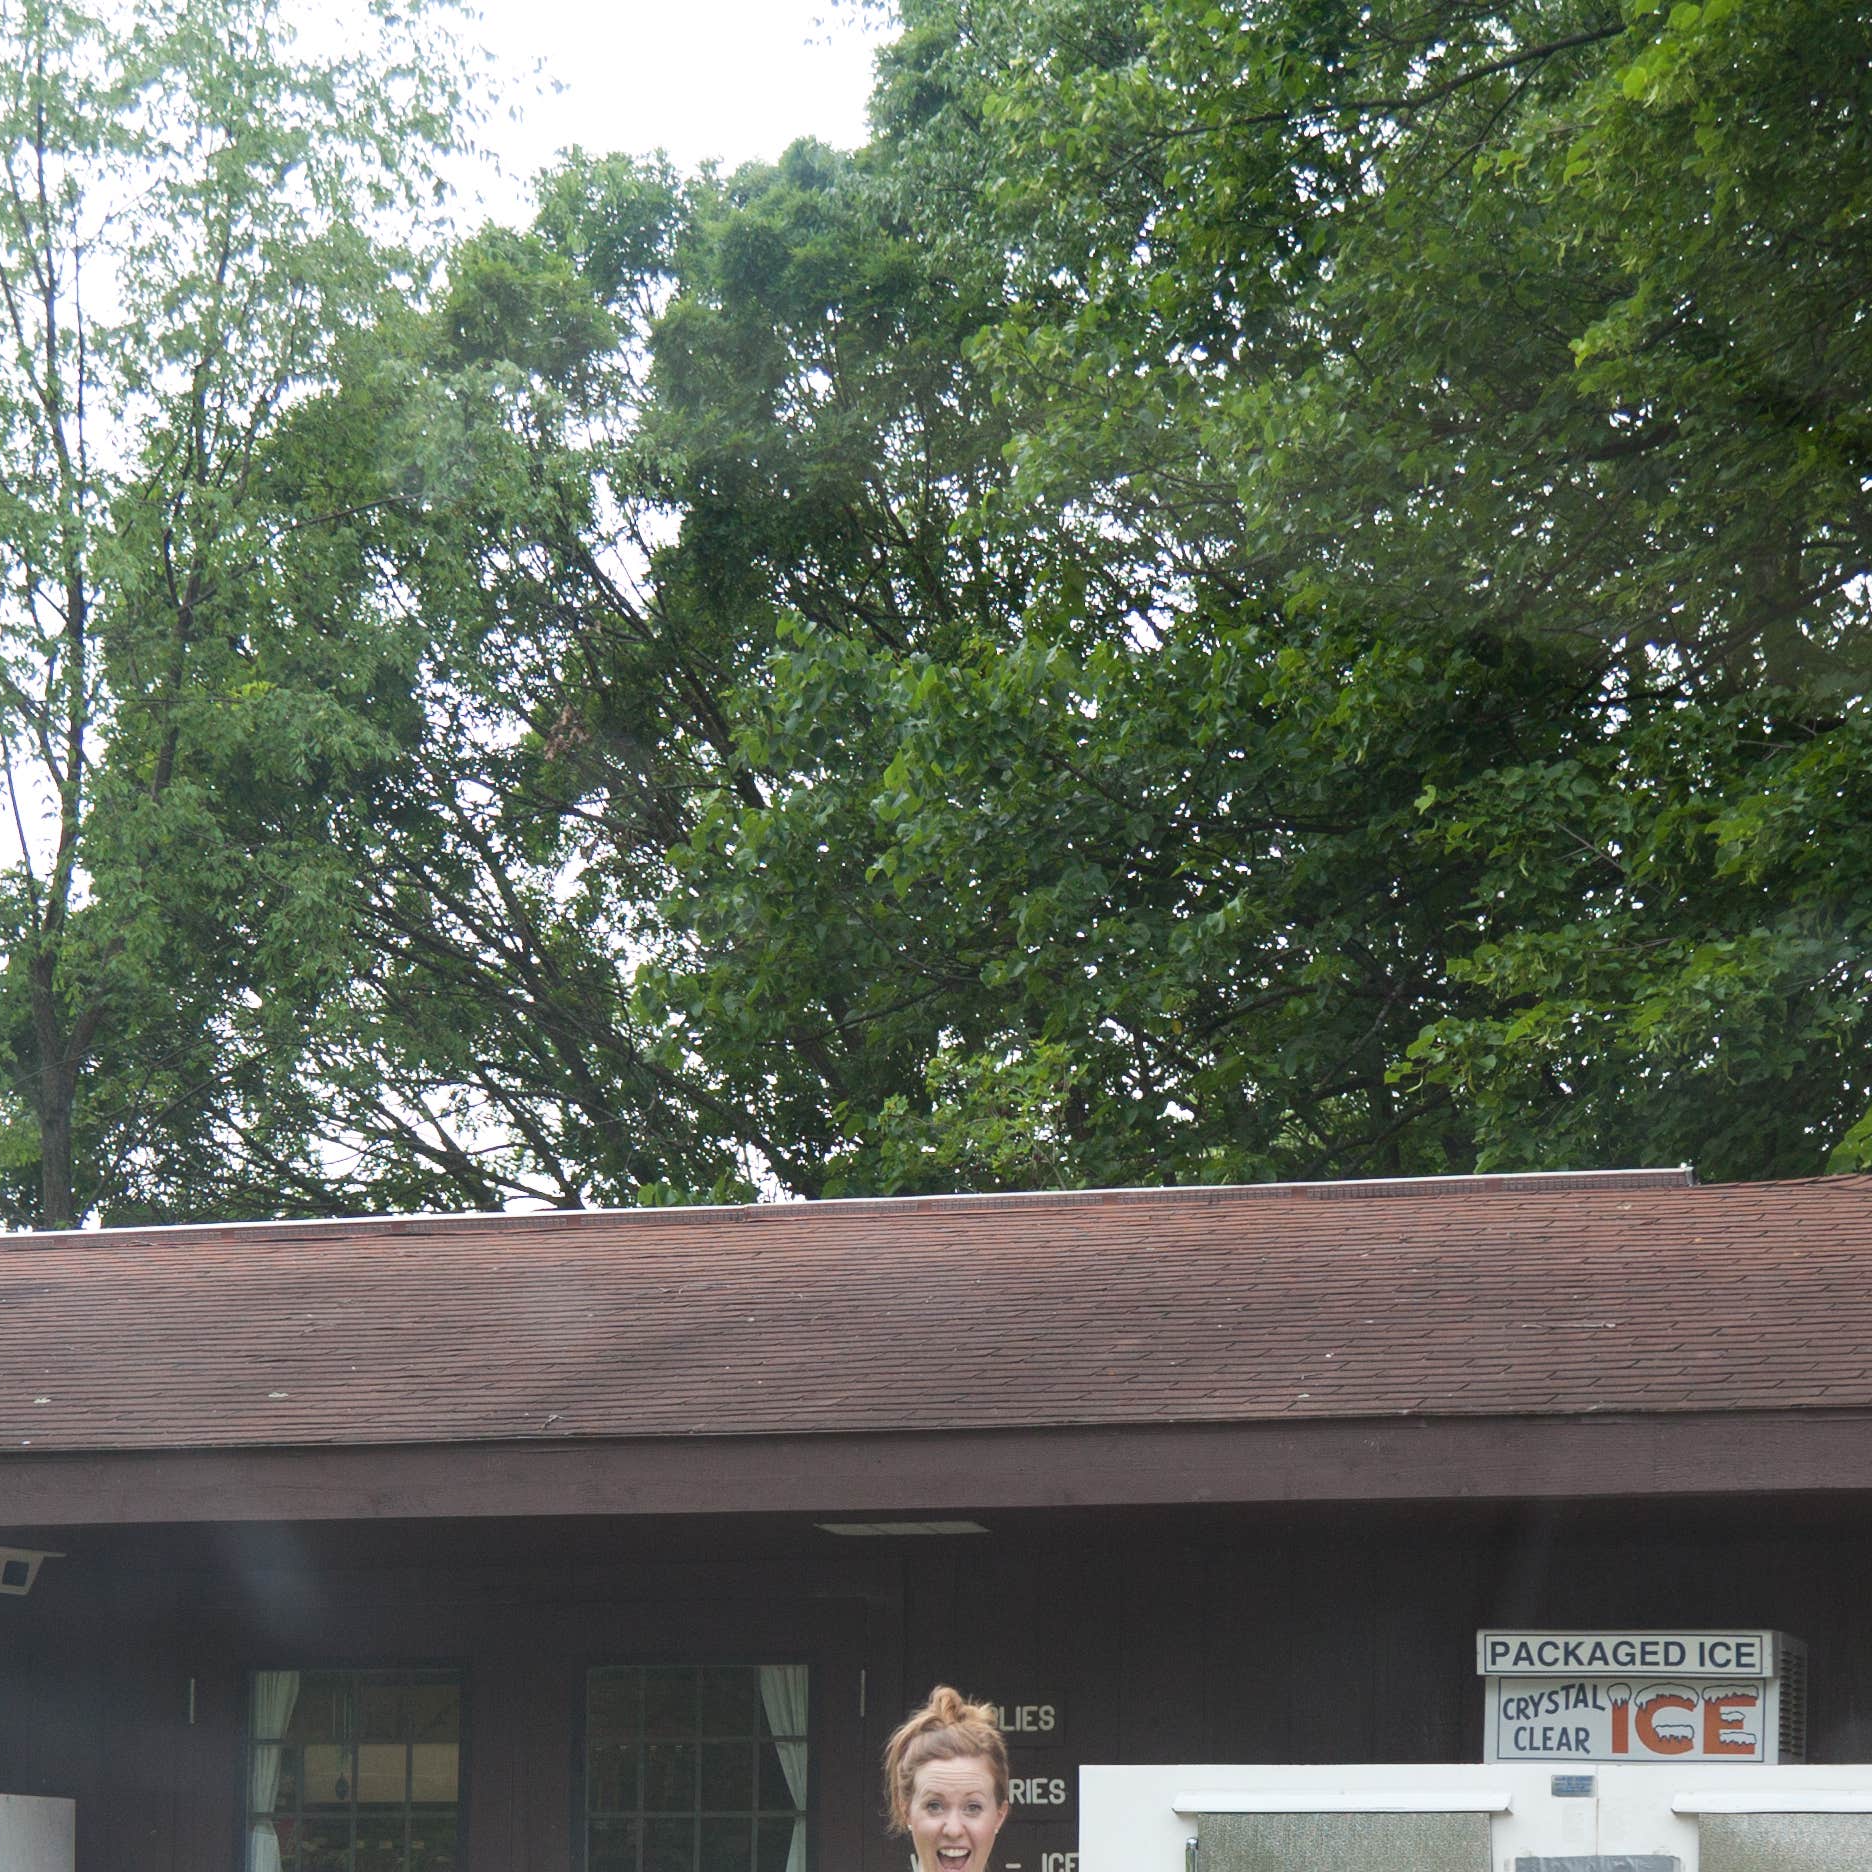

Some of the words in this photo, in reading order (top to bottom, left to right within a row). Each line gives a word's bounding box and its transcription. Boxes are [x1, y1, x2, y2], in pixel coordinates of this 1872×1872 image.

[1489, 1640, 1686, 1668] PACKAGED
[1698, 1641, 1757, 1669] ICE
[1502, 1682, 1607, 1721] CRYSTAL
[1607, 1682, 1760, 1755] ICE
[1513, 1726, 1591, 1754] CLEAR
